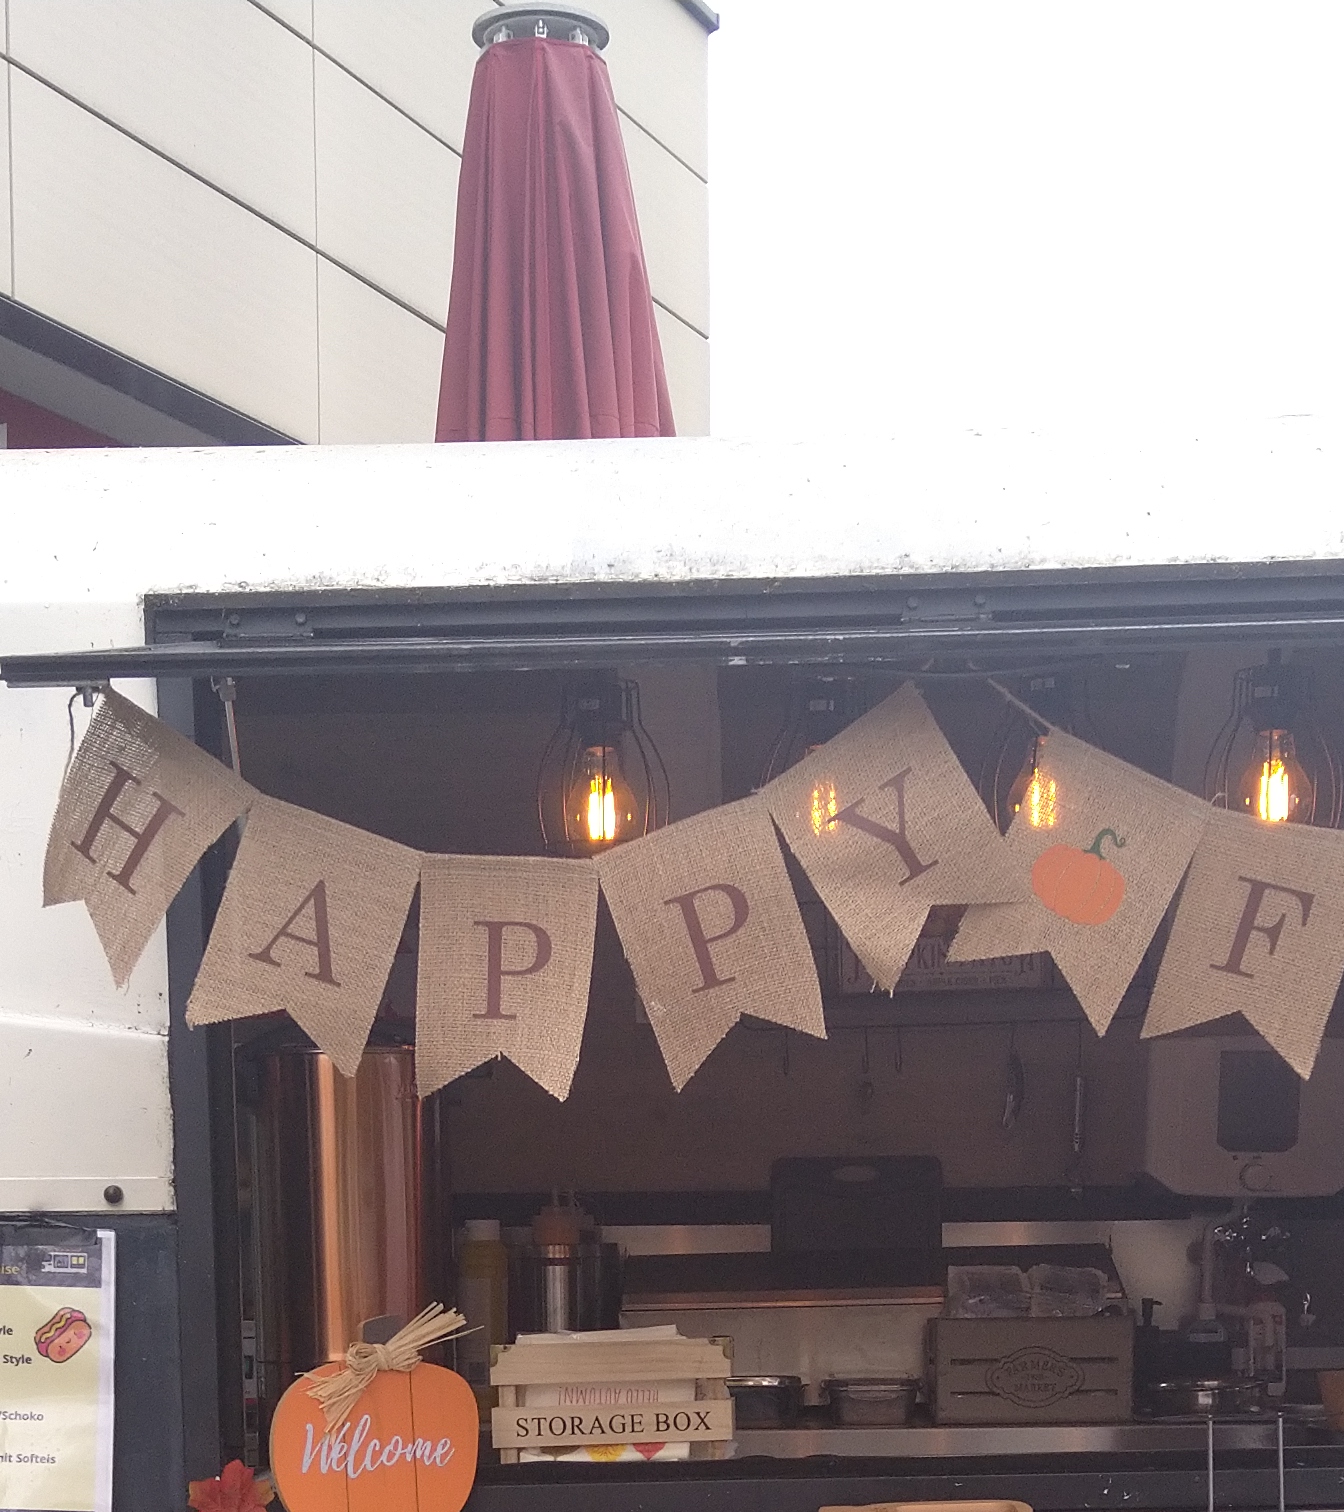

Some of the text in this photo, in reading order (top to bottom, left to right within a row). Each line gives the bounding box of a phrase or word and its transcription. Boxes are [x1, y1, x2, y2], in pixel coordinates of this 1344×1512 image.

[2, 1353, 33, 1366] Style
[515, 1410, 714, 1440] STORAGE BOX
[301, 1414, 457, 1479] Welcome
[15, 1453, 56, 1465] Softeis
